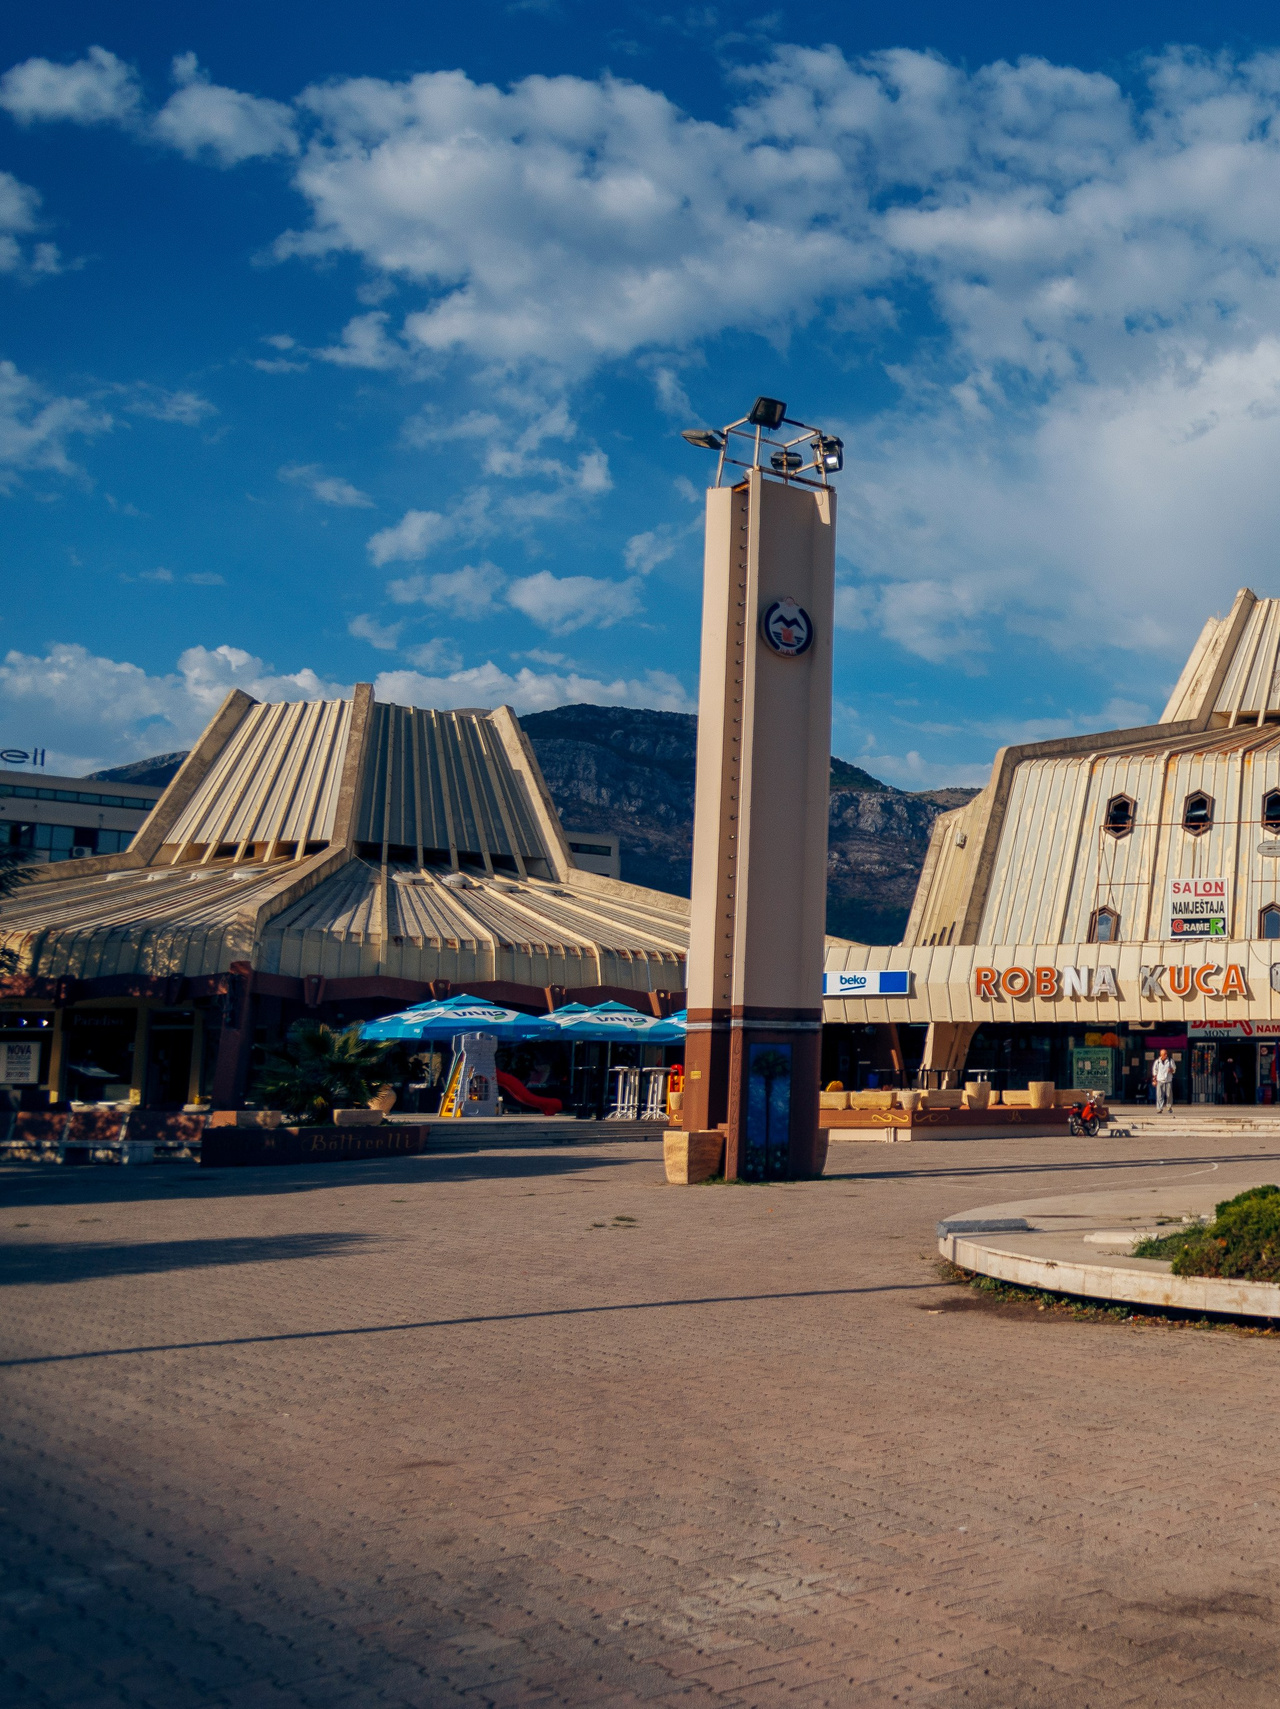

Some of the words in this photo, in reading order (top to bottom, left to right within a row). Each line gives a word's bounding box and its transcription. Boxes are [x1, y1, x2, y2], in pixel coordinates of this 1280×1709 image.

[1172, 881, 1225, 897] SALON
[1172, 898, 1225, 915] NAMJEŠTAJA
[839, 974, 867, 985] beko
[974, 963, 1119, 998] ROBNA
[1204, 1029, 1232, 1037] MONT
[7, 1044, 32, 1055] NOVA
[306, 1133, 416, 1152] Botticelli
